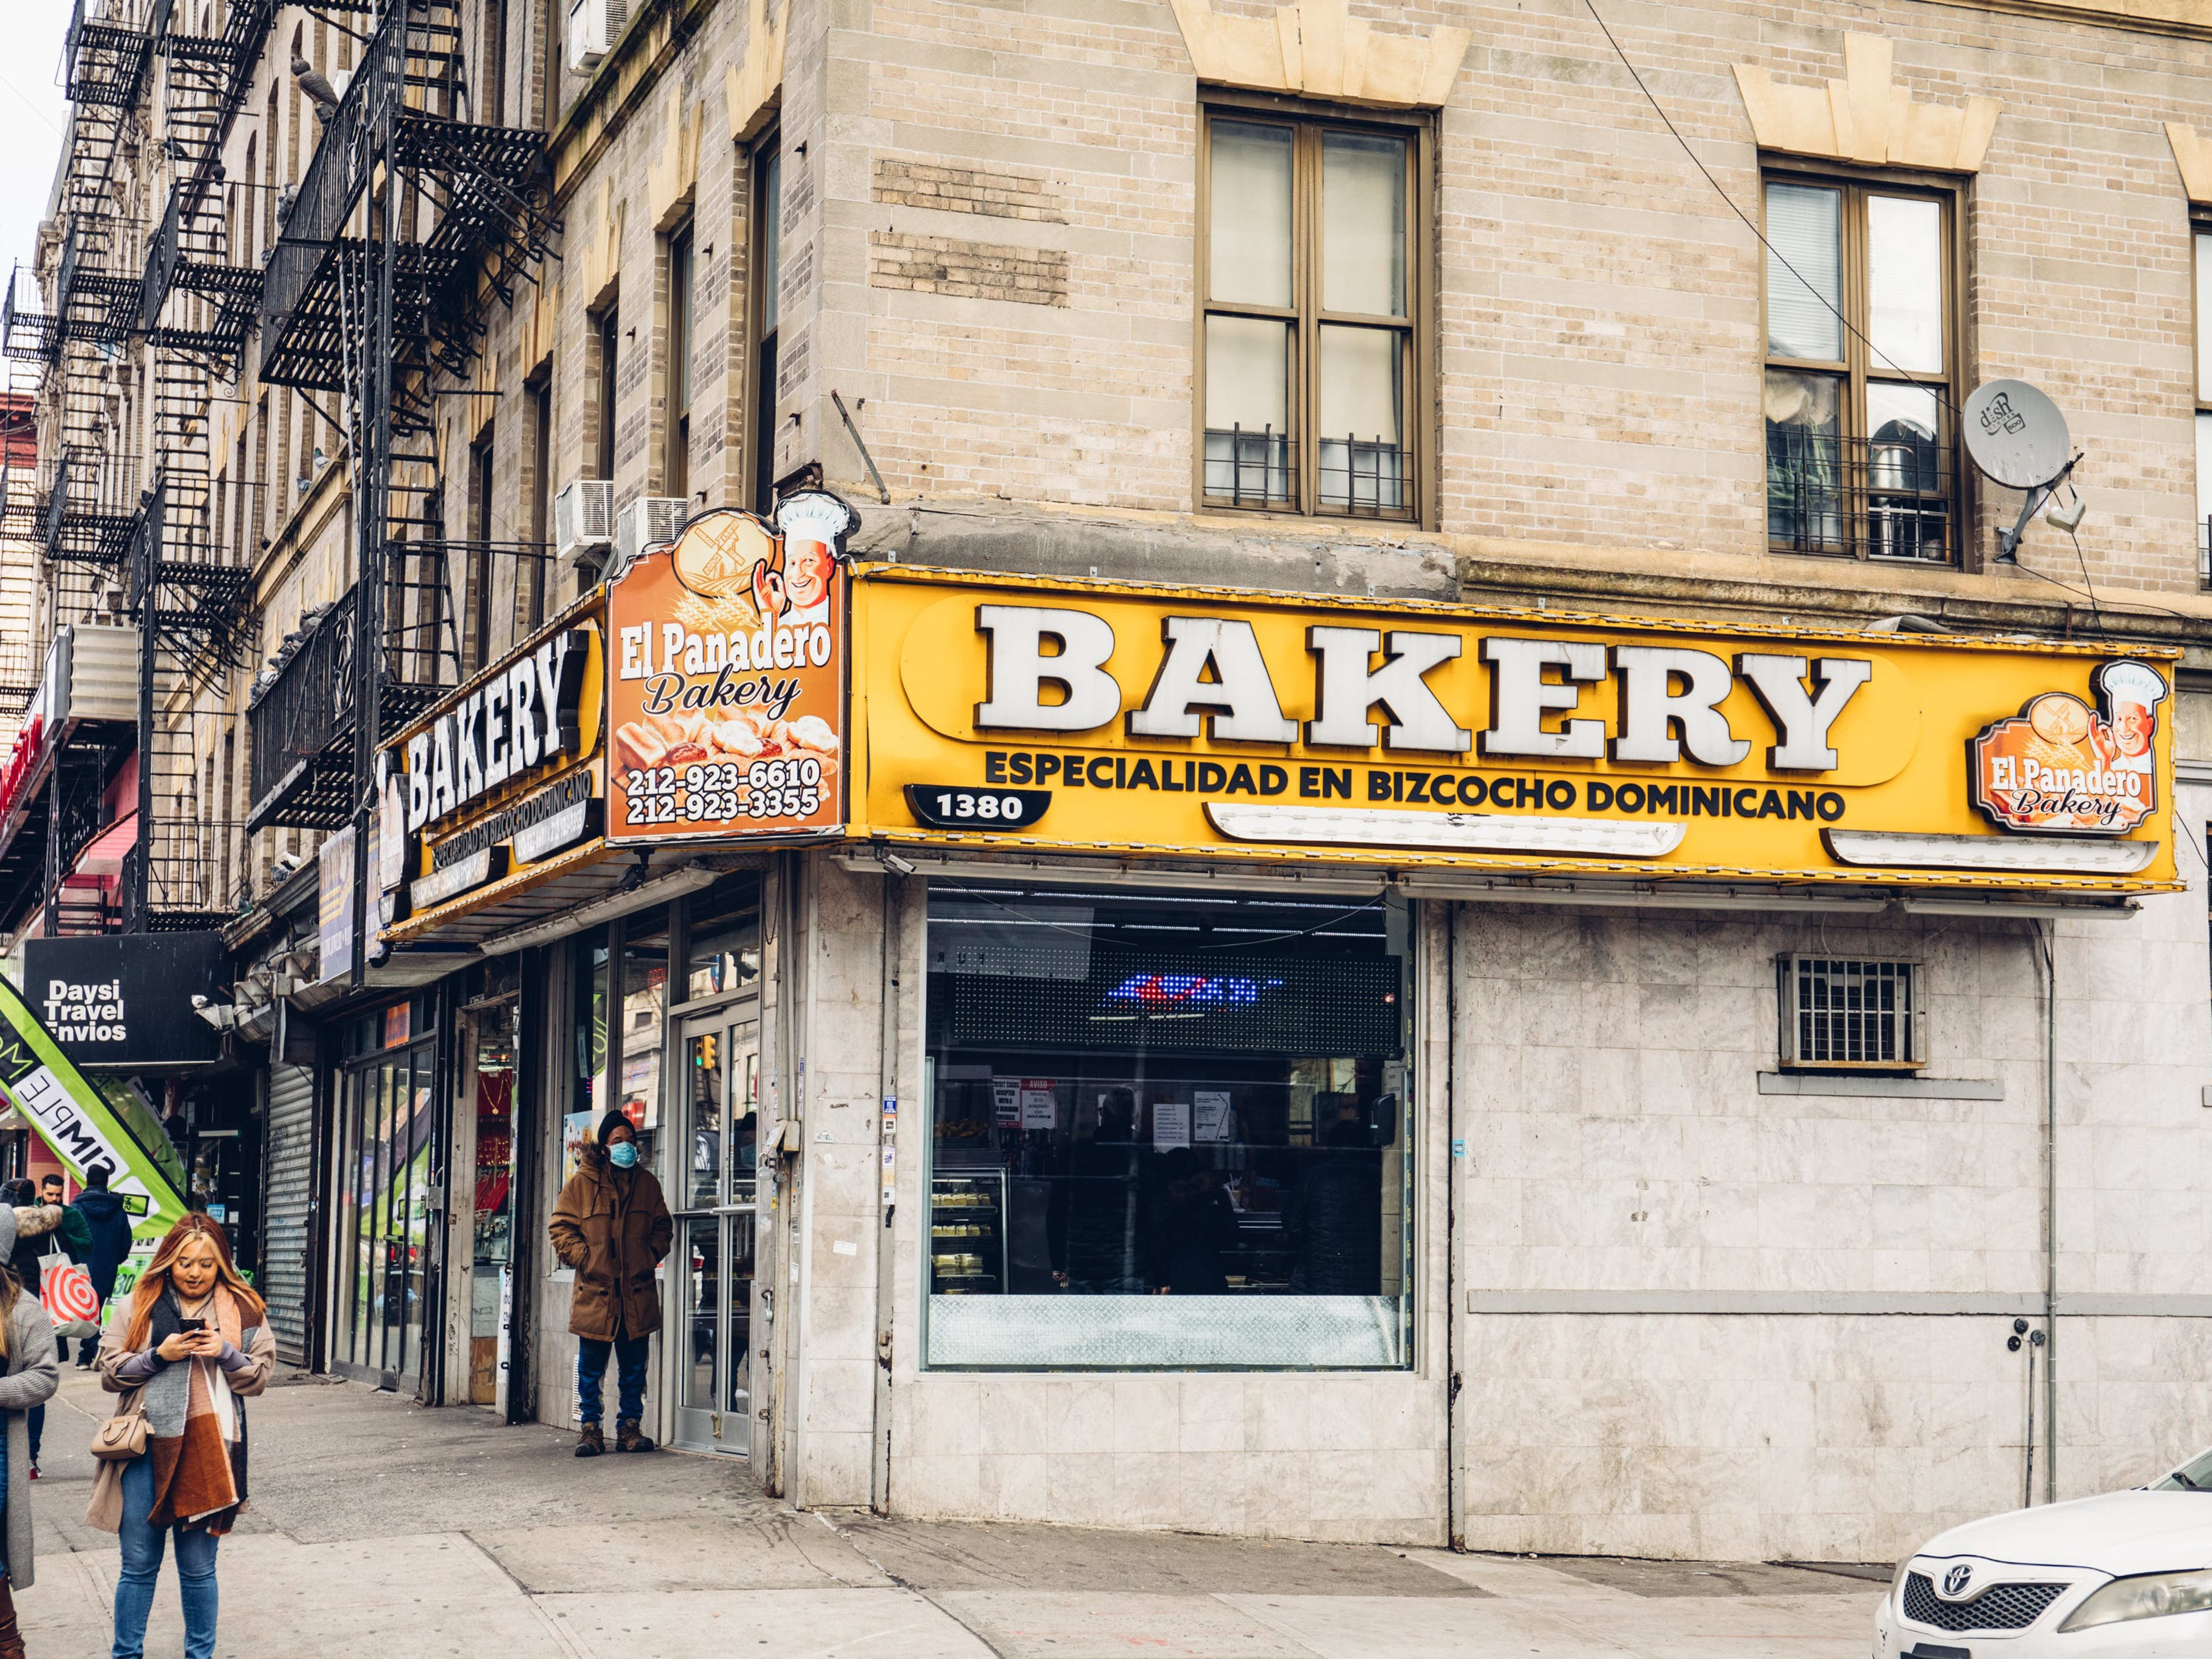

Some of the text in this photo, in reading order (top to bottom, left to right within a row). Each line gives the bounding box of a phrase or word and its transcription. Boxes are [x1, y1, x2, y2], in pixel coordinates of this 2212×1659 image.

[1980, 400, 2013, 428] dish
[2008, 419, 2021, 430] 500
[620, 612, 831, 680] El Panadero
[642, 663, 802, 721] Bakery
[973, 604, 1872, 771] BAKERY
[408, 630, 569, 833] BAKERY
[626, 759, 821, 797] 212-923-6610
[986, 752, 1846, 822] ESPECIALIDAD EN BIZCOCHO DOMINICANO
[1991, 755, 2142, 797] El Panadero
[432, 827, 480, 872] PECIAIDAD
[531, 770, 592, 826] DOMINICANO
[626, 785, 820, 825] 212-923-3355
[936, 794, 1022, 820] 1380
[2010, 789, 2123, 825] Bakery
[43, 999, 123, 1021] Travel
[50, 979, 119, 1005] Daysi
[1029, 1080, 1047, 1089] AVISO
